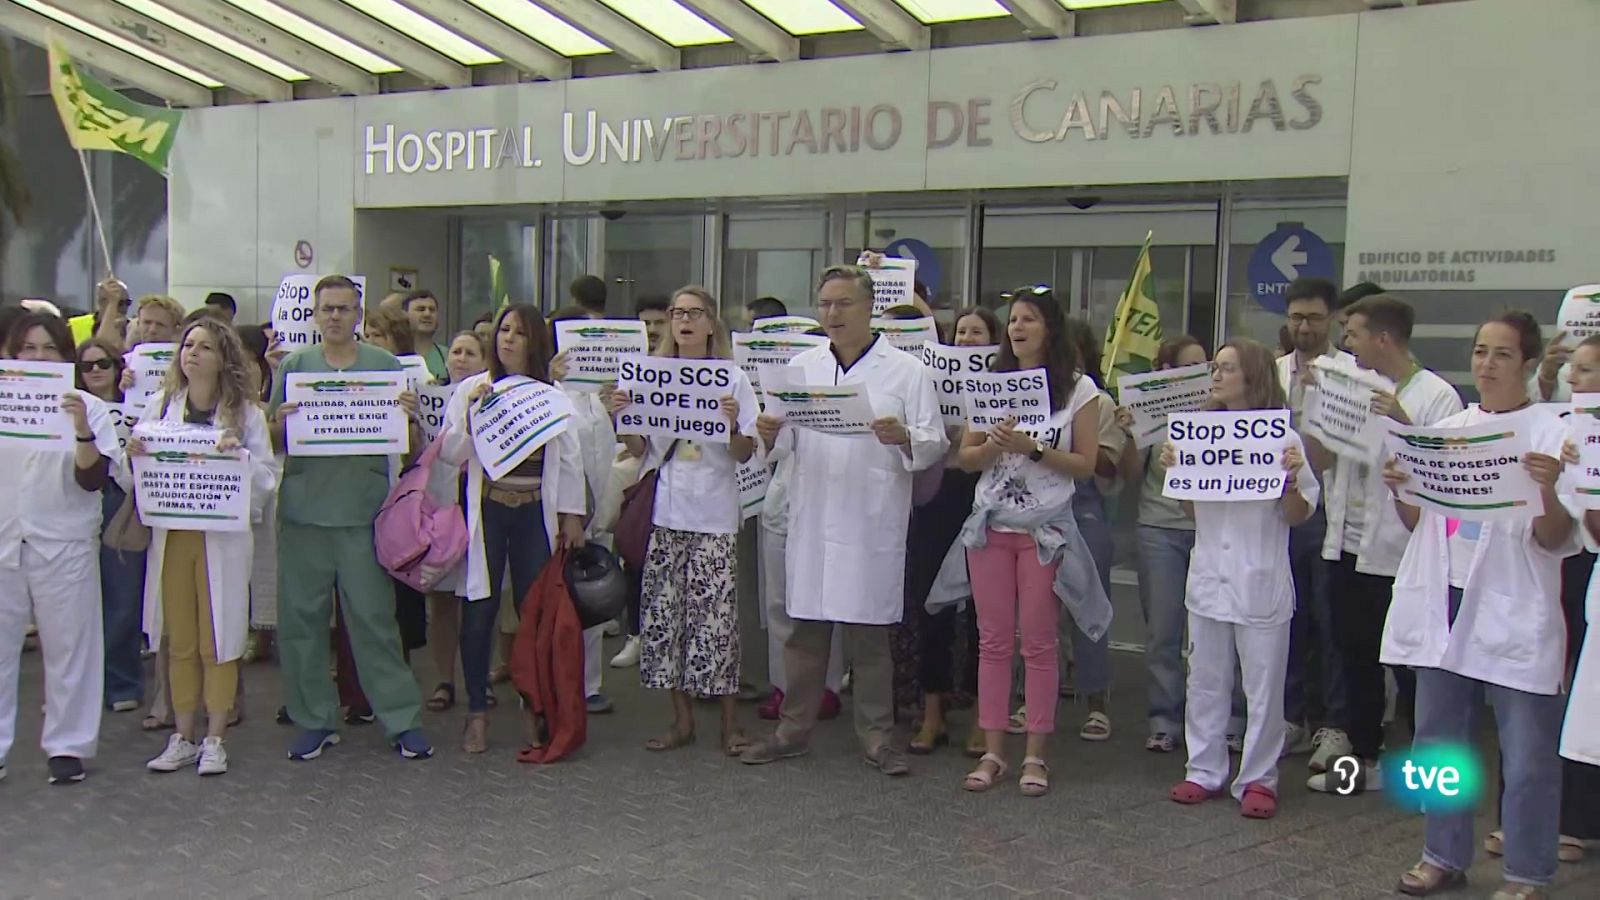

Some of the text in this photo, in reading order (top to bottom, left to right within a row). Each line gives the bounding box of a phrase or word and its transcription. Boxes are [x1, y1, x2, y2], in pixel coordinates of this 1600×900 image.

[926, 98, 992, 149] DE
[1008, 73, 1322, 143] CANARIAS
[1358, 248, 1556, 266] EDIFICIO DE ACTIVIDADES
[1357, 269, 1475, 284] AMBULATORIAS
[278, 281, 309, 304] Stop
[278, 306, 314, 322] la OP
[289, 331, 307, 344] un
[923, 348, 961, 375] Stop
[621, 362, 730, 387] Stop SCS
[966, 375, 1043, 396] Stop SCS
[35, 393, 58, 401] OPE
[629, 390, 719, 410] la OPE no
[974, 398, 1039, 409] la OPE no
[44, 405, 59, 414] DE
[322, 413, 356, 421] GENTE
[358, 412, 389, 420] EXIGE
[486, 434, 498, 443] LA
[498, 412, 525, 434] GENTE
[621, 413, 727, 436] es un juego
[972, 415, 988, 425] es
[314, 426, 382, 435] ESTABILIDAD!
[1170, 418, 1286, 444] Stop SCS
[1180, 449, 1275, 466] la OPE no
[1429, 460, 1446, 469] DE
[1448, 455, 1519, 469] POSESIÓN
[173, 472, 187, 480] DE
[189, 473, 242, 483] EXCUSAS!
[1413, 467, 1500, 482] ANTES DE LOS
[173, 482, 187, 490] DE
[1169, 474, 1281, 494] es un juego
[199, 502, 217, 511] YA!
